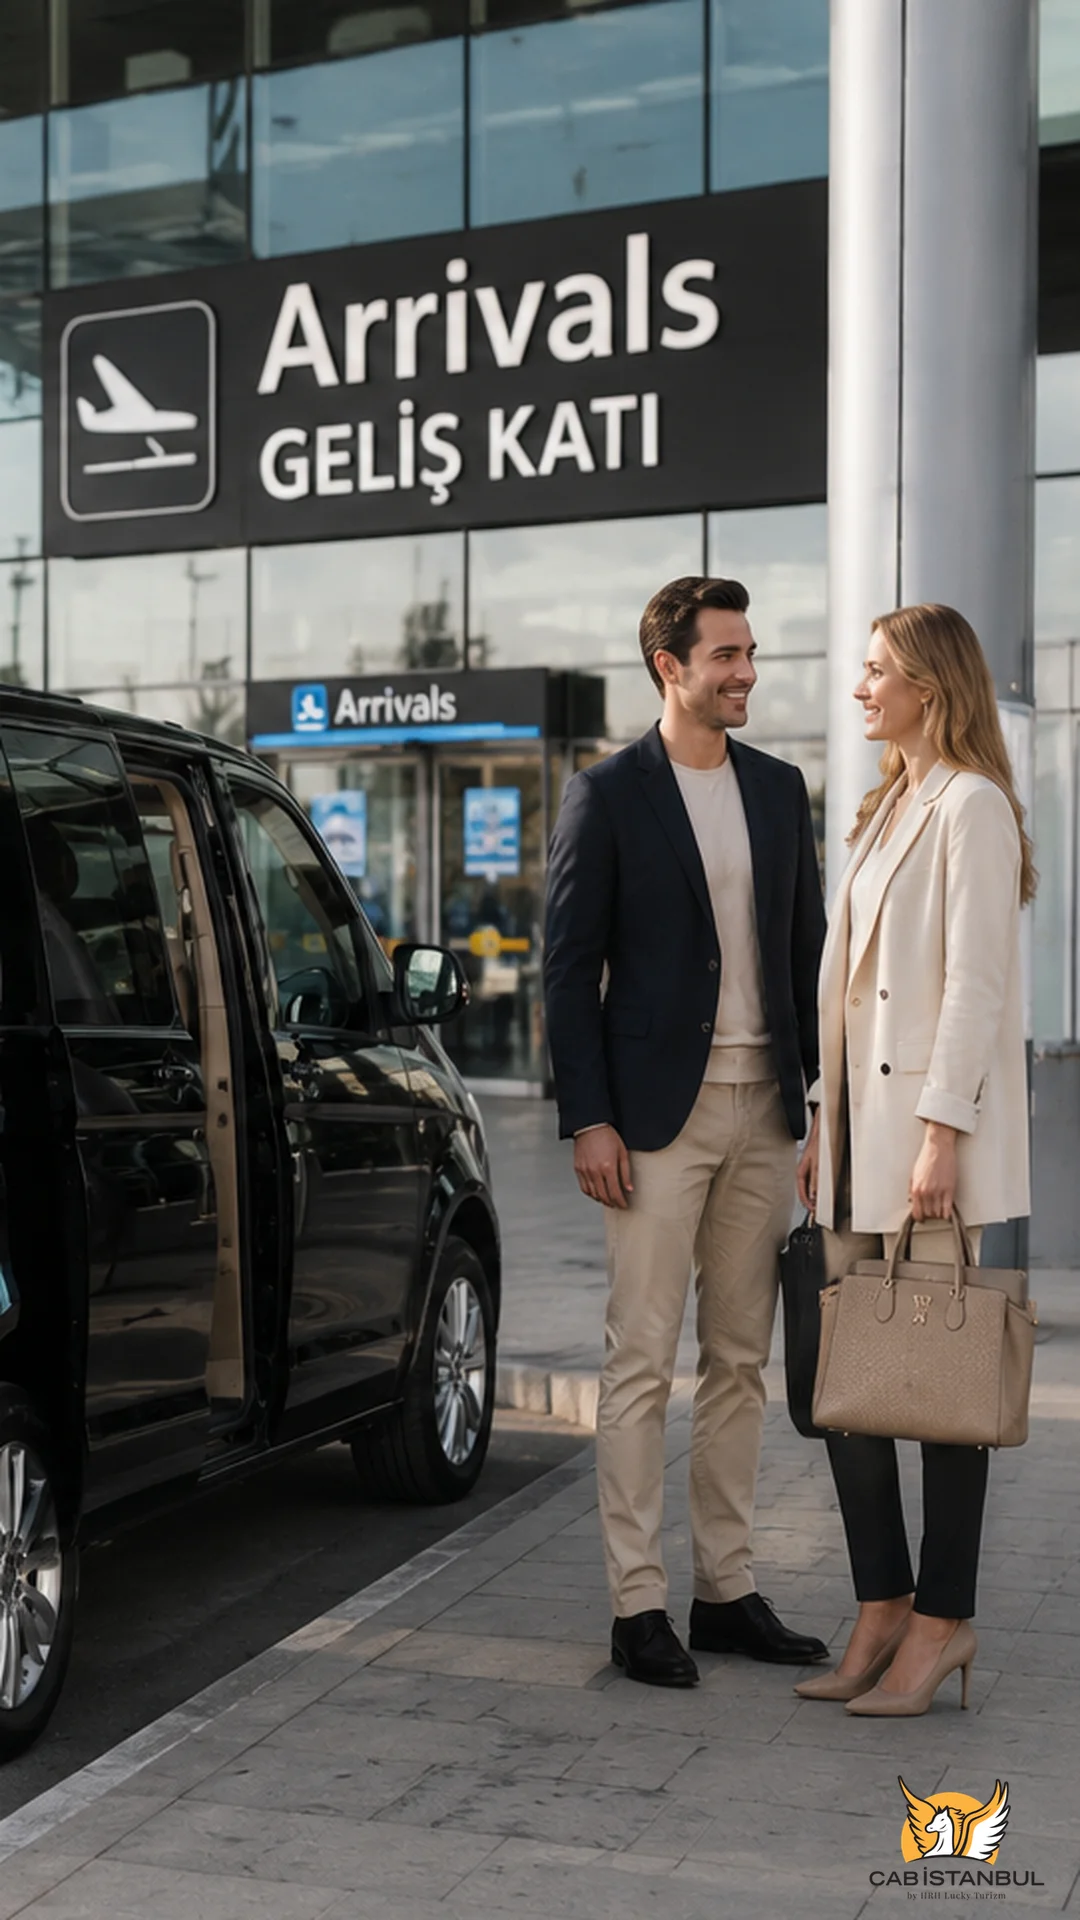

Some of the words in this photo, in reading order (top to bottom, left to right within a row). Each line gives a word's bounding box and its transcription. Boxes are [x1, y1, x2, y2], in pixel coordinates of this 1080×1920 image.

[257, 233, 720, 394] Arrivals
[259, 400, 462, 505] GELİŞ
[488, 393, 659, 480] KATI
[334, 684, 457, 724] Arrivals
